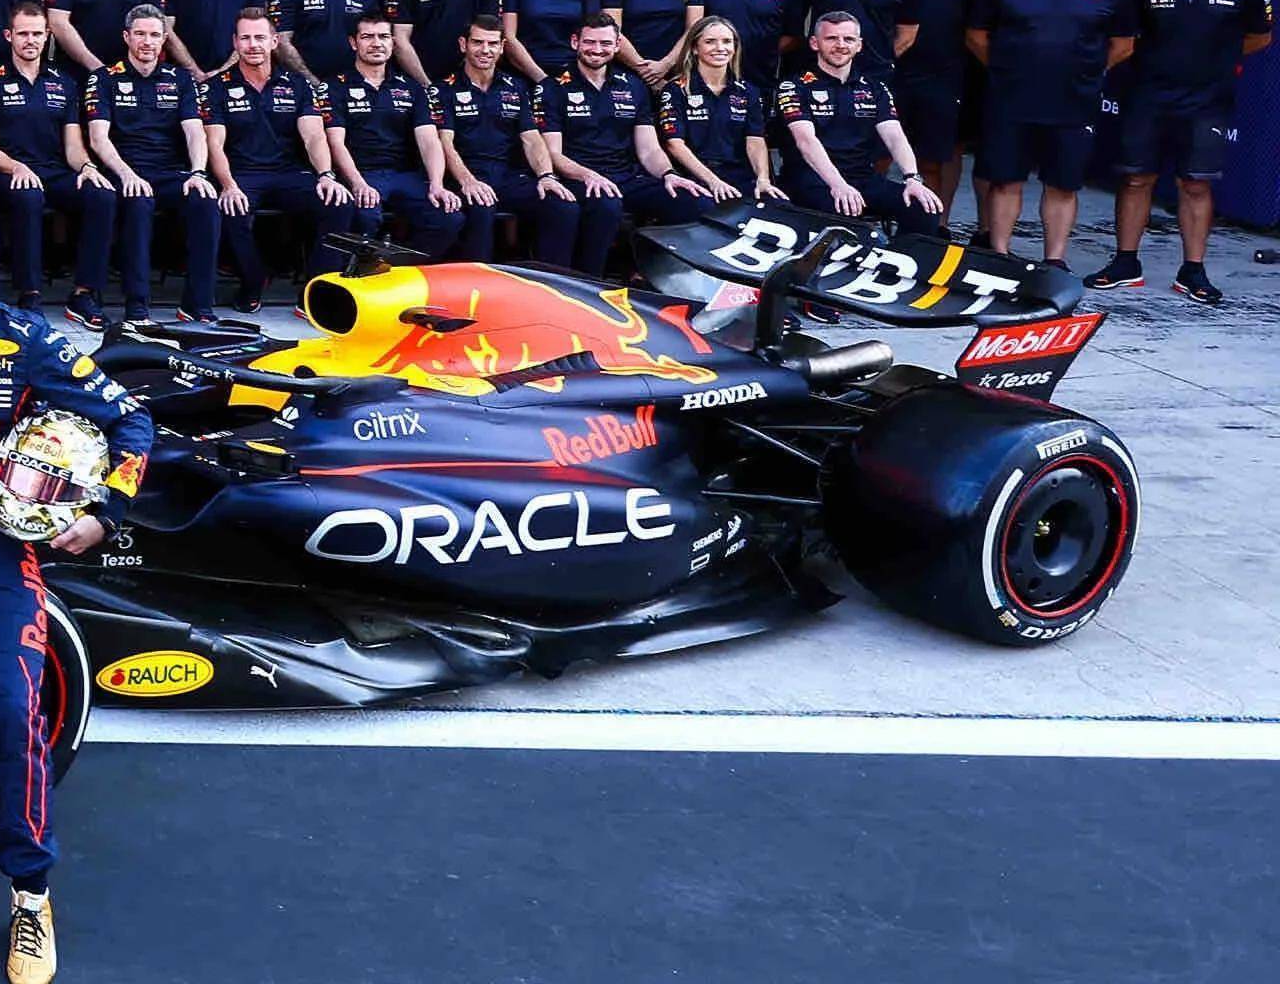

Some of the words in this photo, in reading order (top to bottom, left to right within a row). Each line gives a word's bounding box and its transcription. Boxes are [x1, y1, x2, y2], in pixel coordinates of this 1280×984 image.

[967, 327, 1055, 361] Mobil
[999, 369, 1053, 389] Tezos
[680, 382, 768, 411] HONDA
[353, 411, 427, 441] citrix
[1035, 429, 1088, 459] PIRELLI
[9, 452, 72, 480] ORACLE
[304, 488, 677, 567] ORACLE
[101, 554, 143, 568] Tezos
[127, 665, 199, 685] RAUCH
